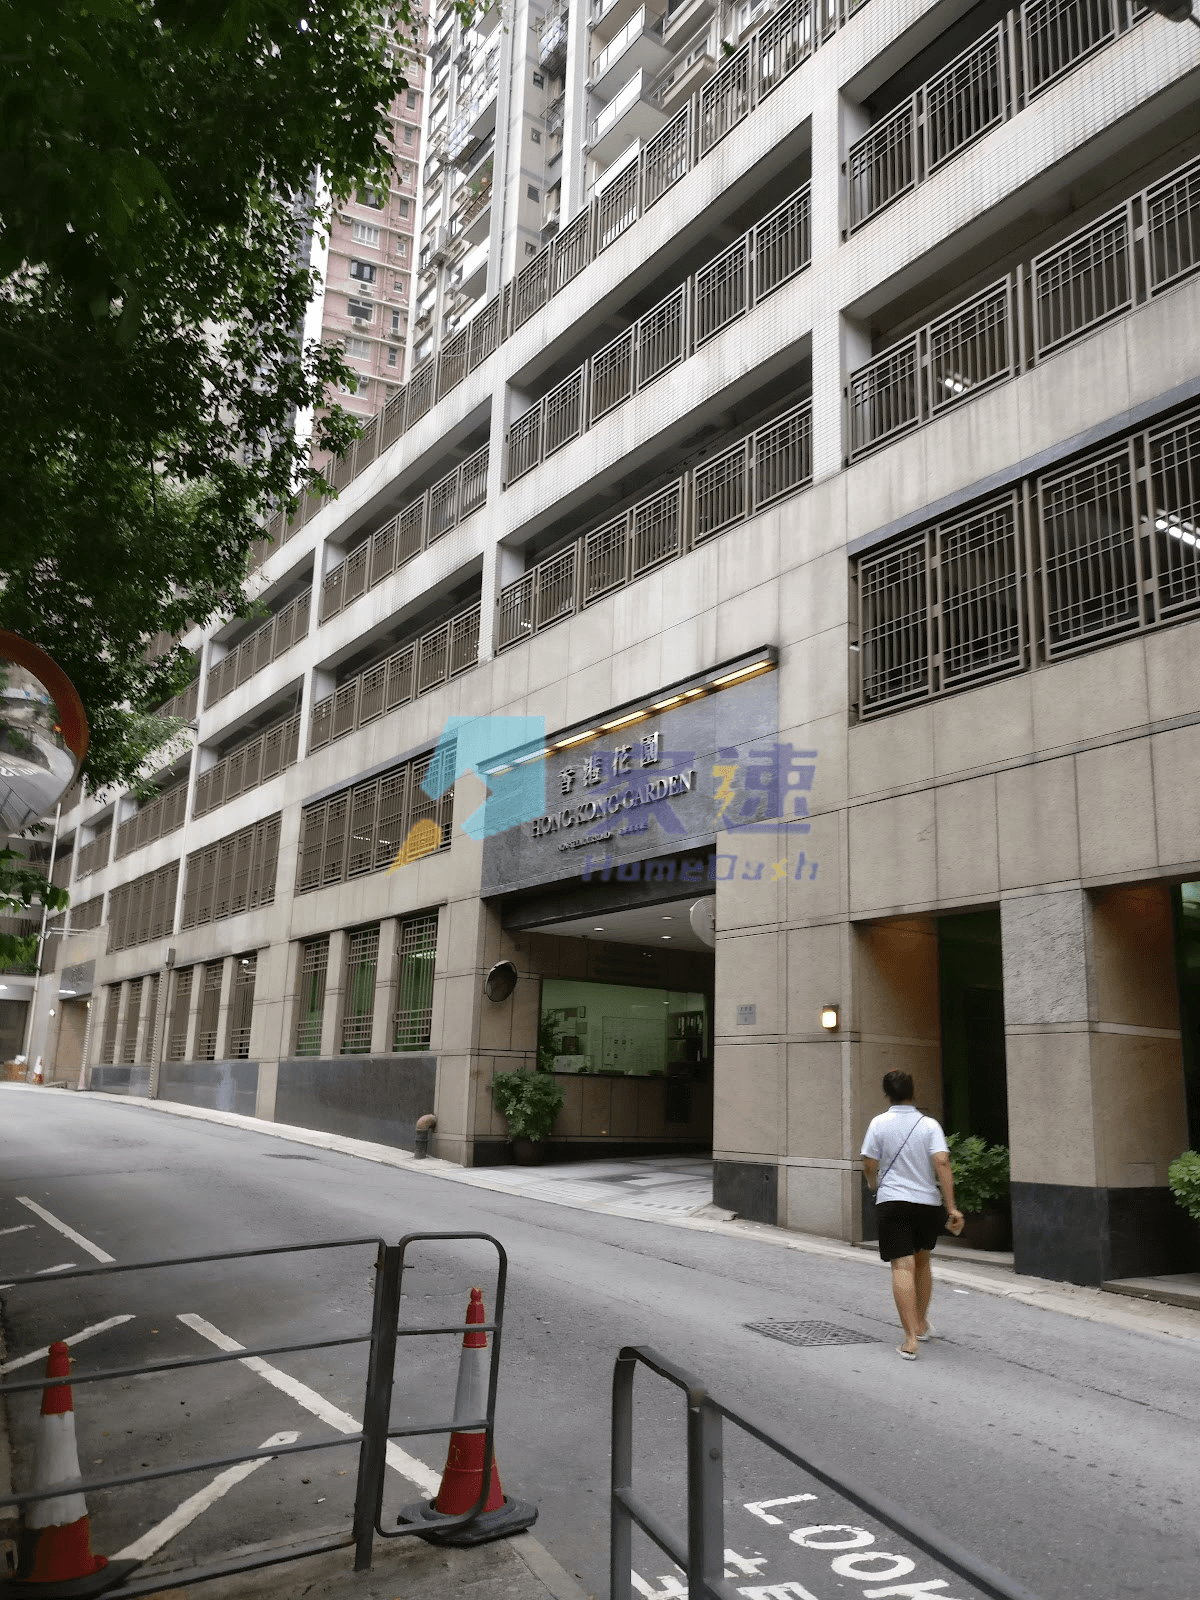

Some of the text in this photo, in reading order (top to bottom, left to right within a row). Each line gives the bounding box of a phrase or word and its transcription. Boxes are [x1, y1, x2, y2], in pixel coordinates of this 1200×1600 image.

[557, 731, 660, 795] 香港花園
[531, 769, 695, 837] HONG KONG GARDEN
